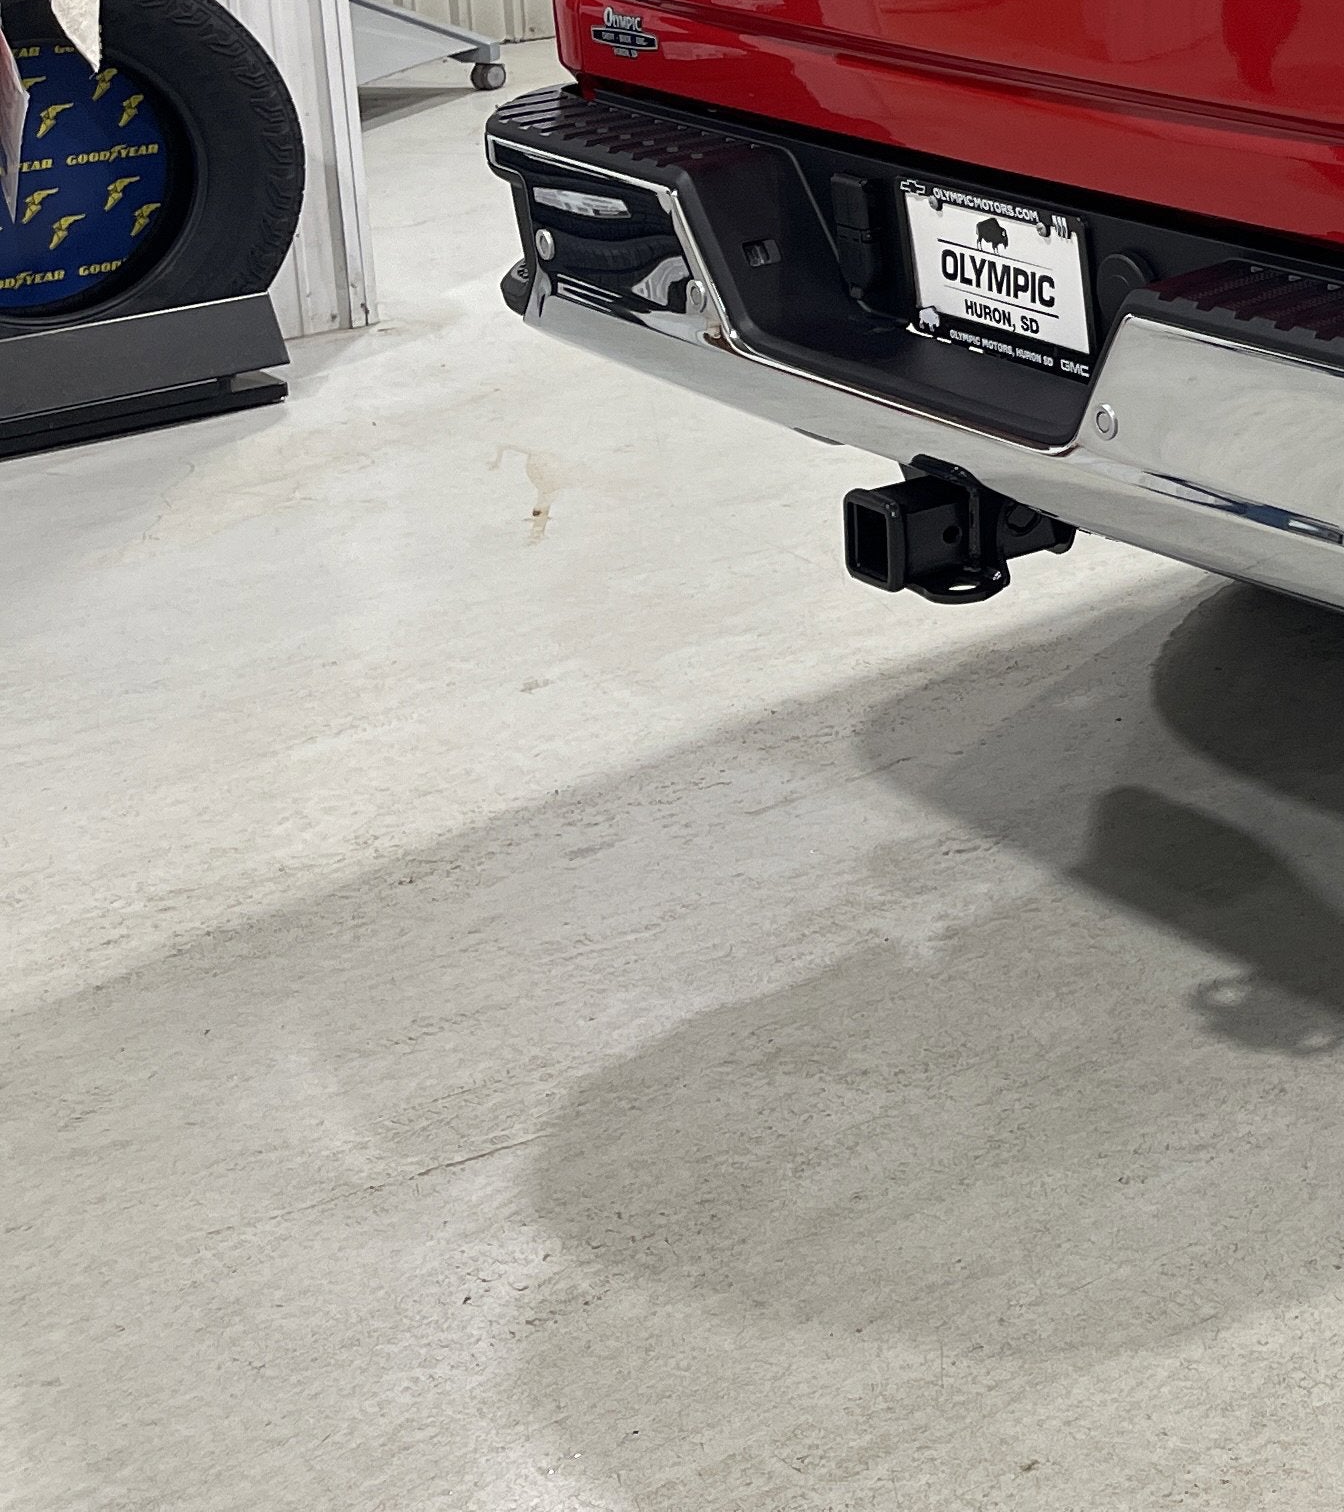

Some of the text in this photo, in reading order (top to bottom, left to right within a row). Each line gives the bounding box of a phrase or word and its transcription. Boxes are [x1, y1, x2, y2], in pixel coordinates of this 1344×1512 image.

[66, 144, 159, 167] GOODYEAR
[932, 187, 1039, 223] OLYMPICMOTORS.COM
[941, 249, 1056, 308] OLYMPIC
[965, 299, 1040, 335] HURON, SD
[1060, 359, 1090, 378] GMC
